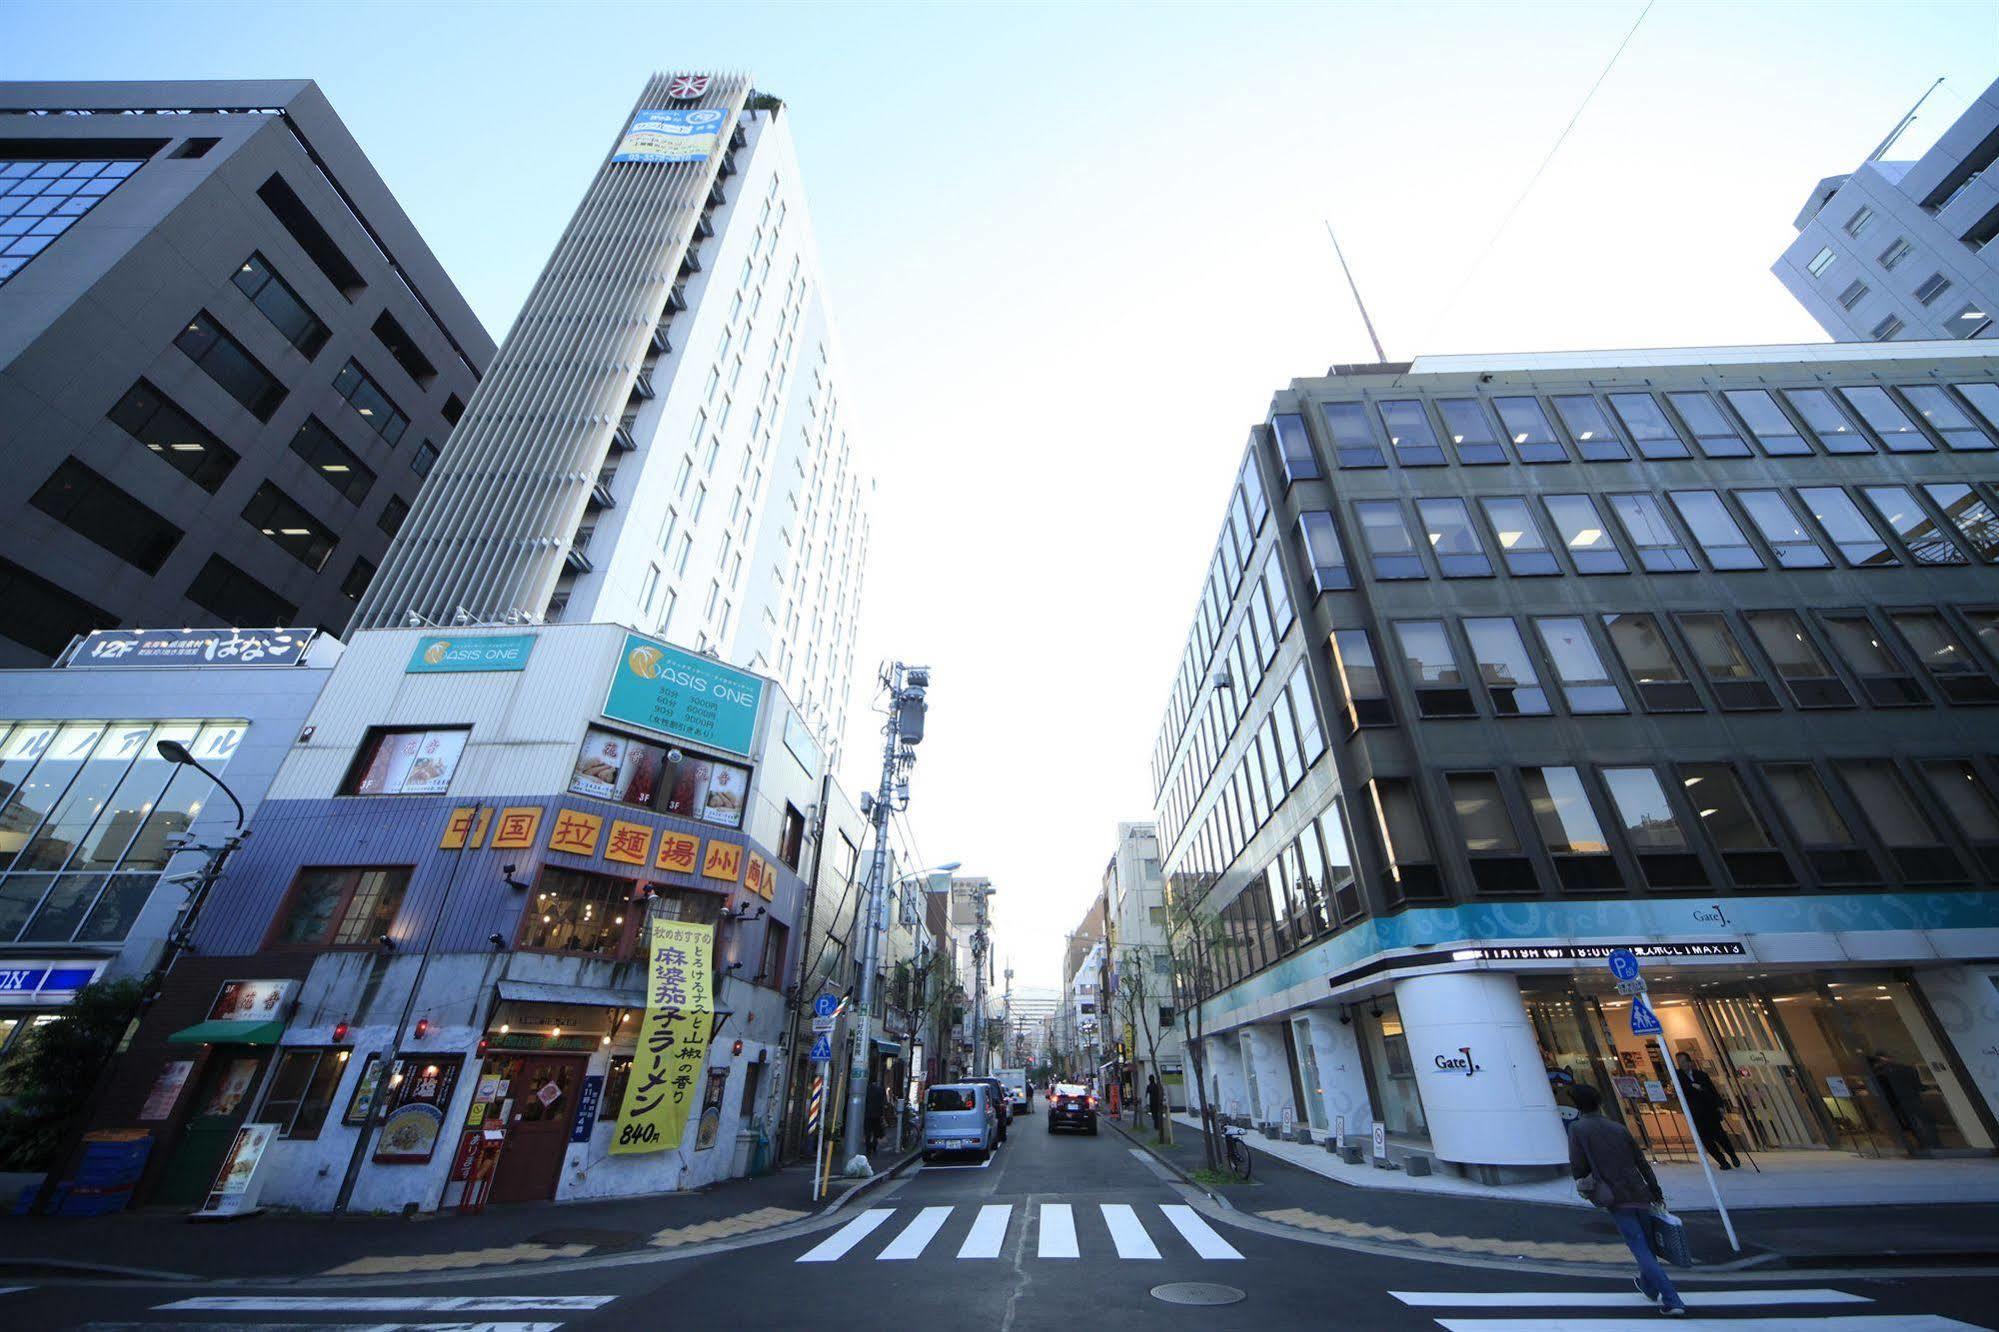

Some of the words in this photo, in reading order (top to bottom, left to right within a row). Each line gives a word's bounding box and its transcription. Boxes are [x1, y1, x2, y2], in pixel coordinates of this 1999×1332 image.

[205, 634, 292, 661] はなこ
[485, 648, 519, 660] ONE
[713, 684, 754, 708] ONE
[16, 728, 242, 757] ルノアル
[639, 793, 650, 802] 3F
[668, 801, 680, 810] 3F
[653, 927, 712, 944] 秋のおすすめ
[630, 946, 689, 1118] 麻婆茄子ラーメン
[672, 946, 710, 1104] とろけるナスと山椒の香り
[620, 1123, 660, 1145] 840円
